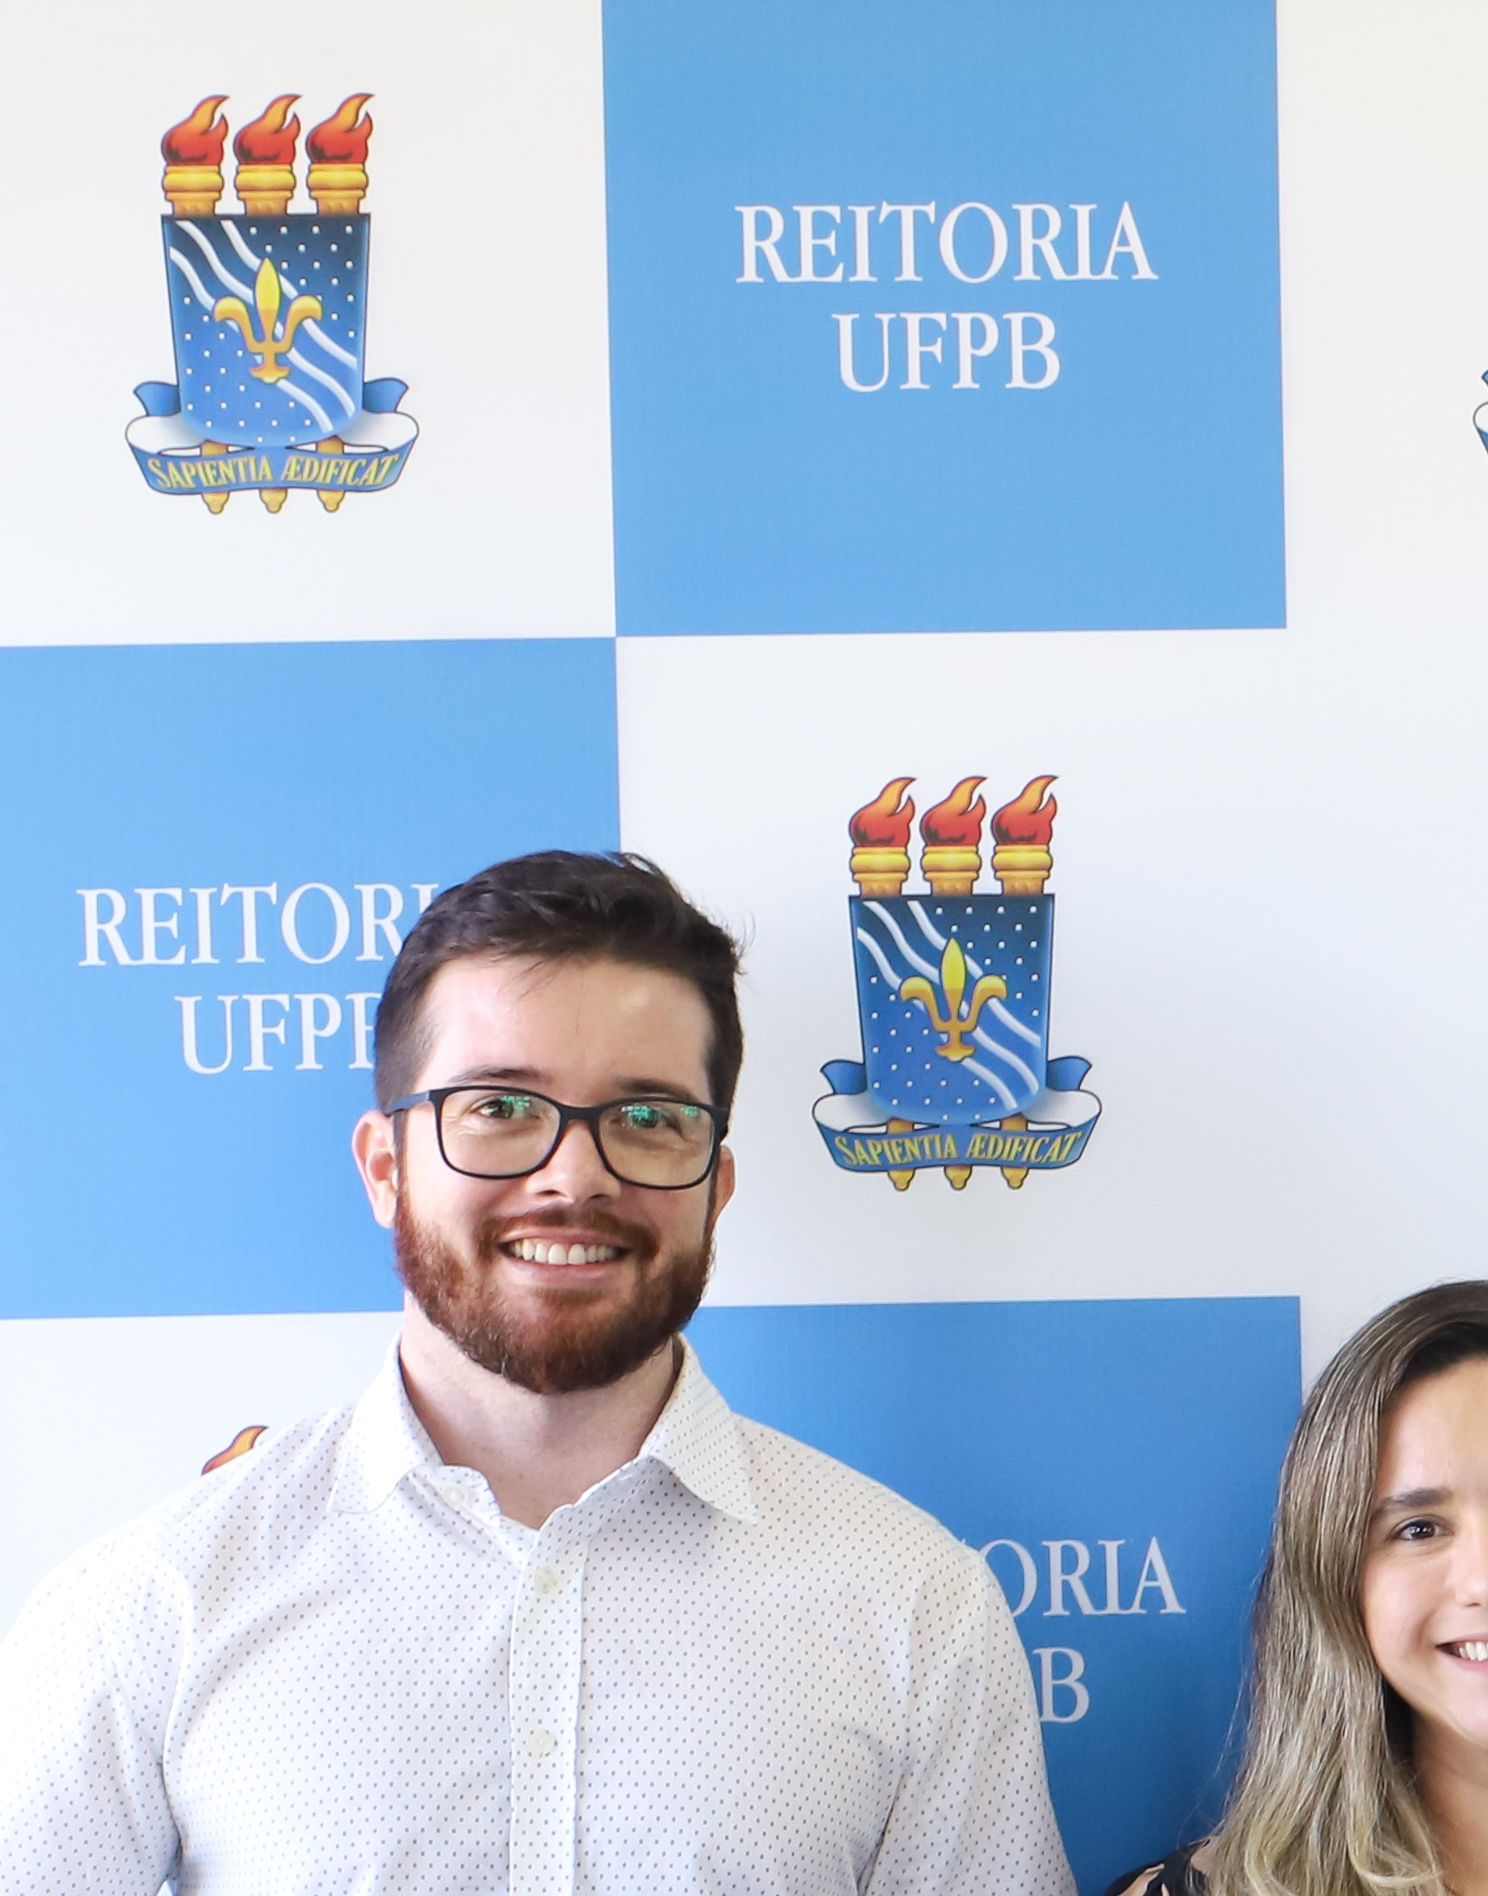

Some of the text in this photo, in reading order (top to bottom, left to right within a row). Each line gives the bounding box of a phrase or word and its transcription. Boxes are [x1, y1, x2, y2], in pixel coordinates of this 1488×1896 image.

[735, 201, 1158, 283] REITORIA
[832, 312, 1060, 392] UFPB
[148, 455, 273, 489] SAPIENTIA
[77, 881, 439, 966] REITOR
[834, 1133, 959, 1166] SAPIENTIA
